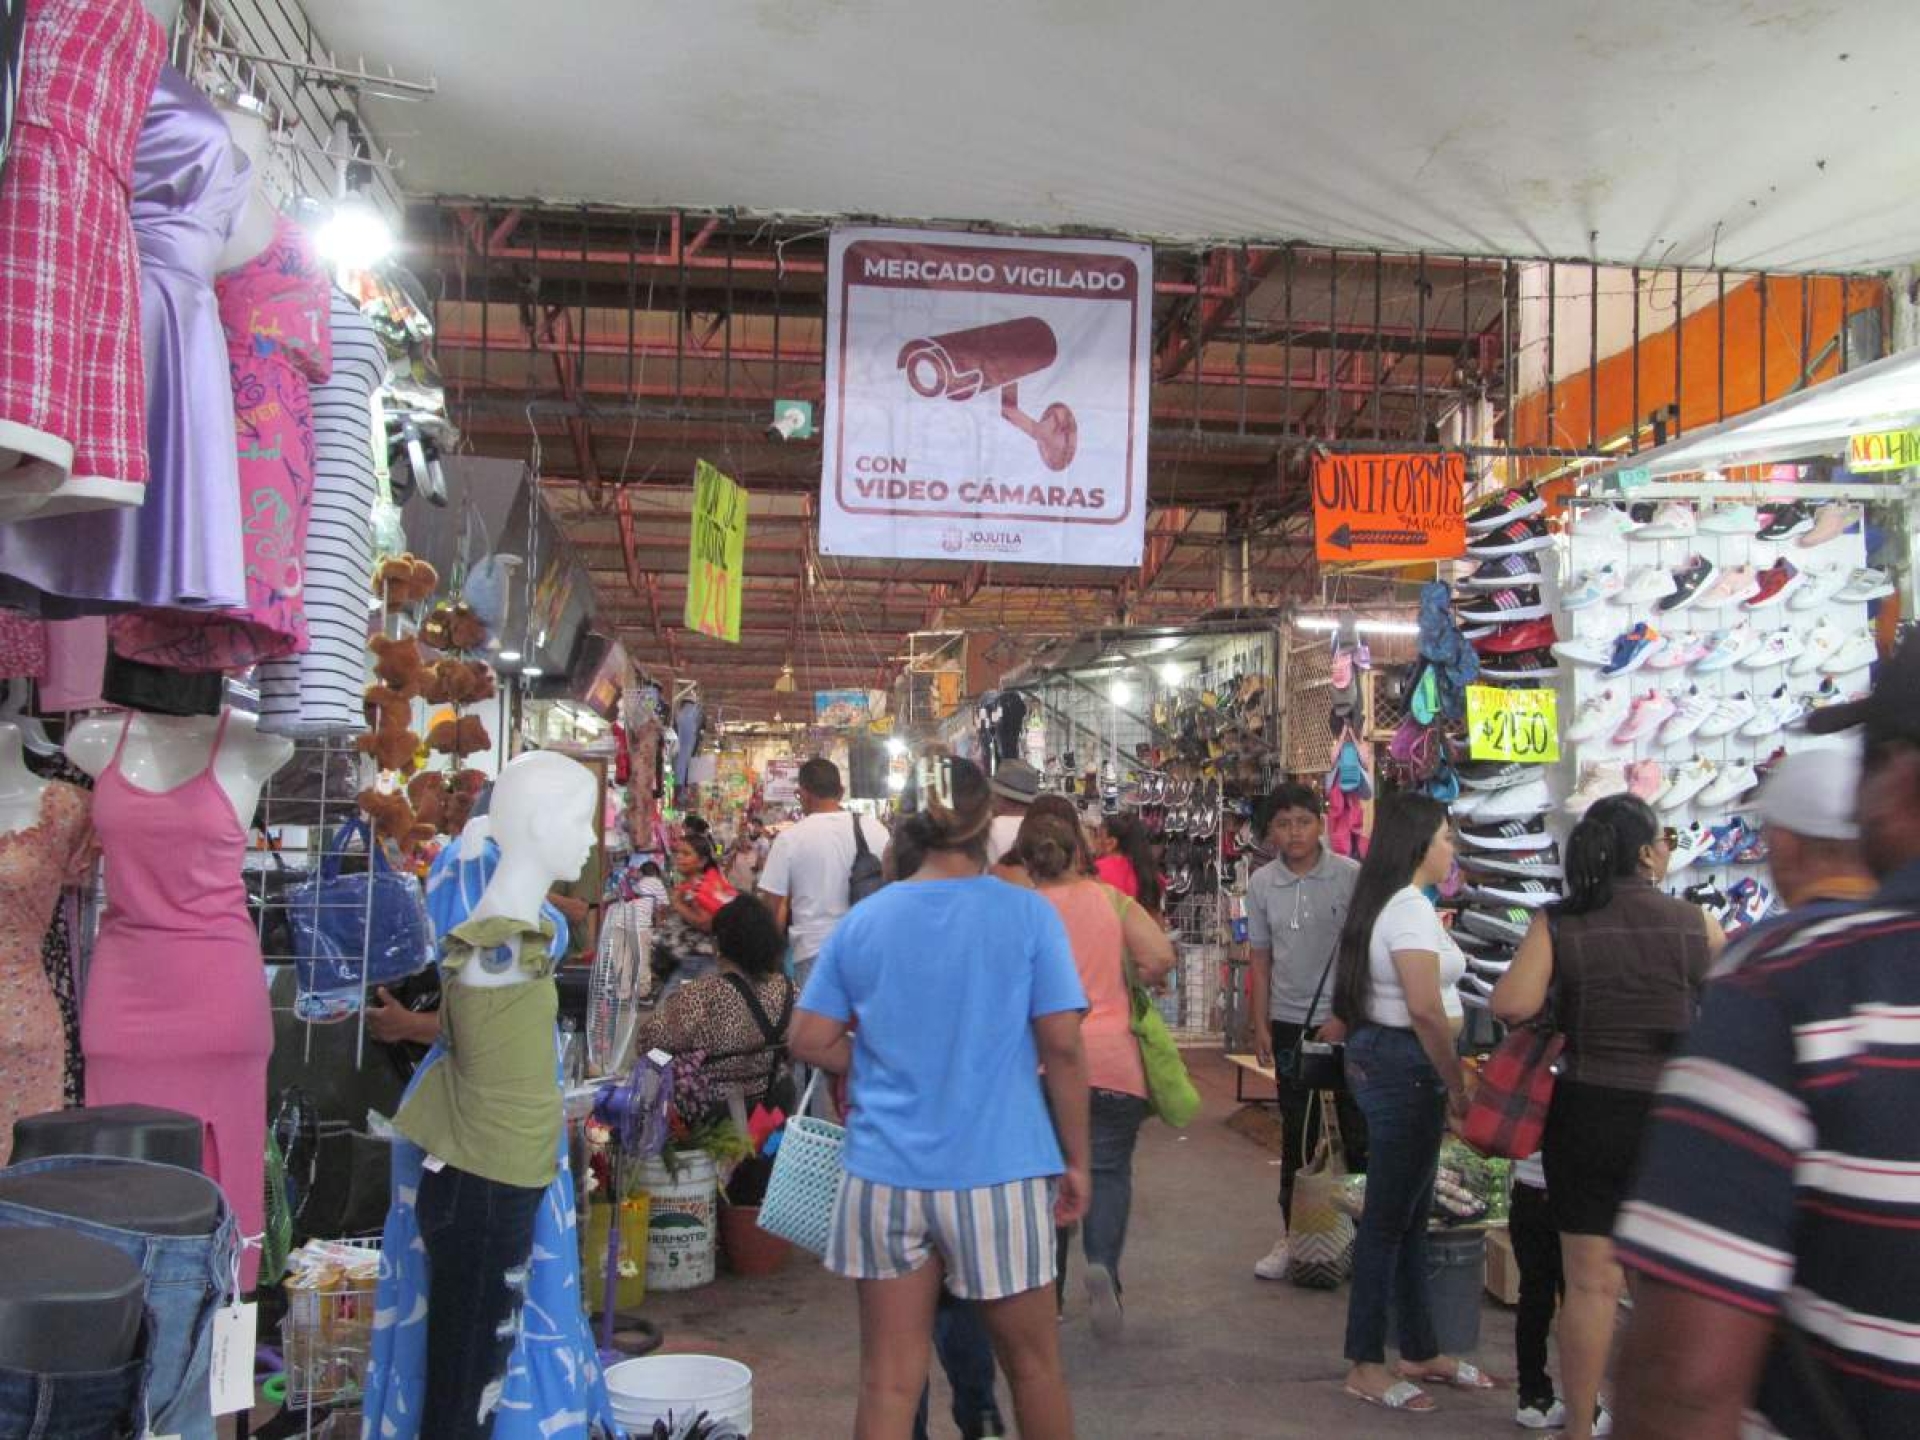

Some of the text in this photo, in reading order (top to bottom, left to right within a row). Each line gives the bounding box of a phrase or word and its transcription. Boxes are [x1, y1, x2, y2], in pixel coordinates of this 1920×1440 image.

[864, 258, 1125, 291] MERCADO VIGILADO
[856, 456, 907, 475] CON
[855, 477, 1105, 509] VIDEO CÁMARAS
[1315, 454, 1464, 515] UNIFORMES
[965, 530, 1022, 545] JOJUTLA
[1482, 709, 1548, 756] $250
[668, 1252, 680, 1269] 5
